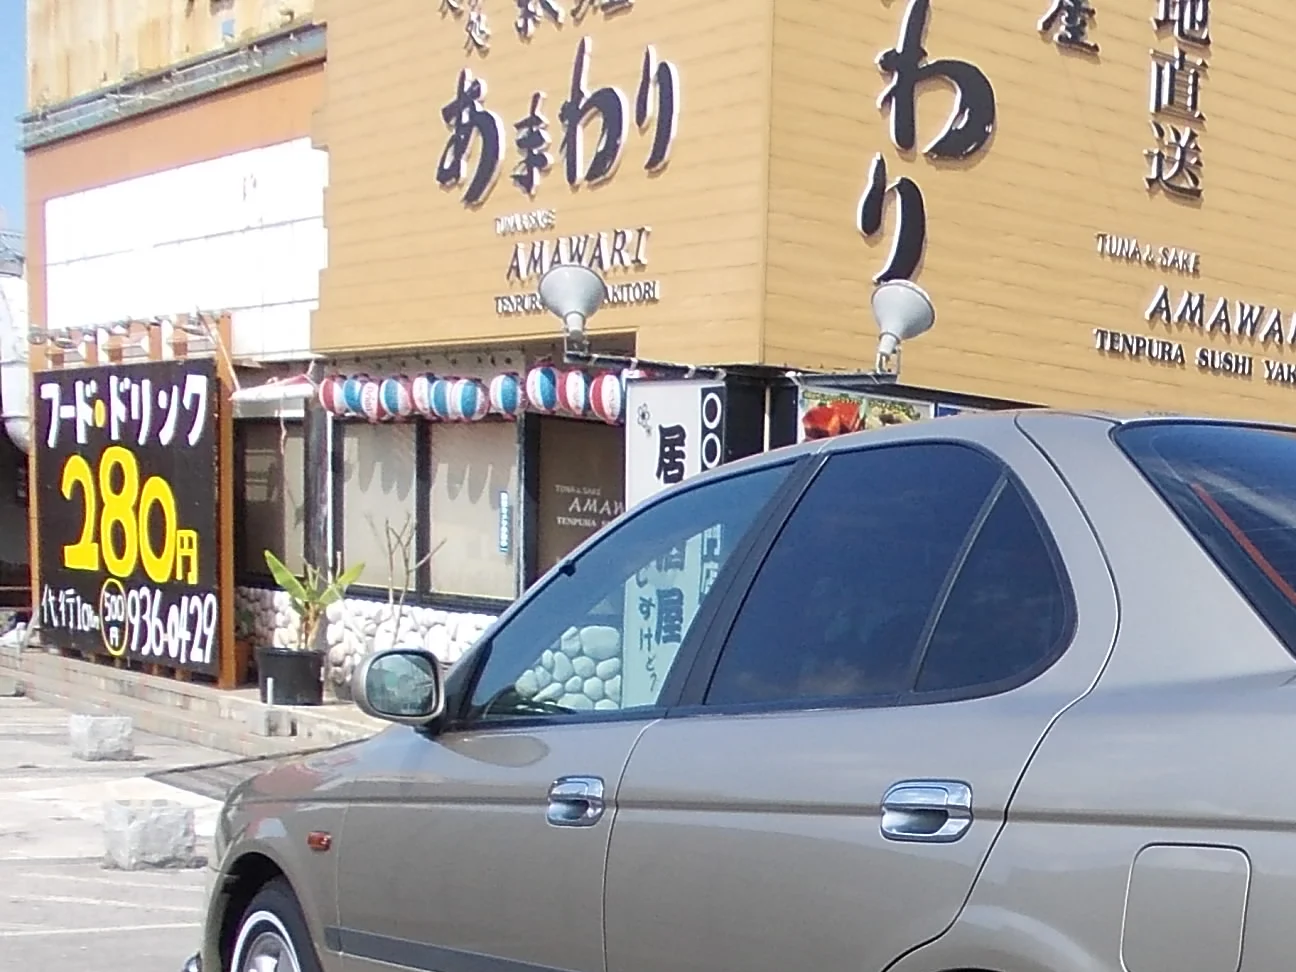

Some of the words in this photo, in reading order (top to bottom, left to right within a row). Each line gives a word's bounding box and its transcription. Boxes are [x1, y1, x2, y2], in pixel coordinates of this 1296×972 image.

[436, 36, 679, 206] あまわり
[857, 0, 996, 286] わり
[506, 227, 652, 281] AMAWARI
[1095, 233, 1141, 262] TUNA
[1159, 246, 1201, 273] SAKE
[494, 292, 545, 314] TENPUR
[602, 281, 661, 304] AKITORI
[1093, 328, 1186, 364] TENPURA
[1196, 348, 1254, 377] SUSHI
[41, 374, 208, 448] フード・ドリンク
[61, 446, 199, 585] 280円
[130, 586, 217, 664] 936-0429
